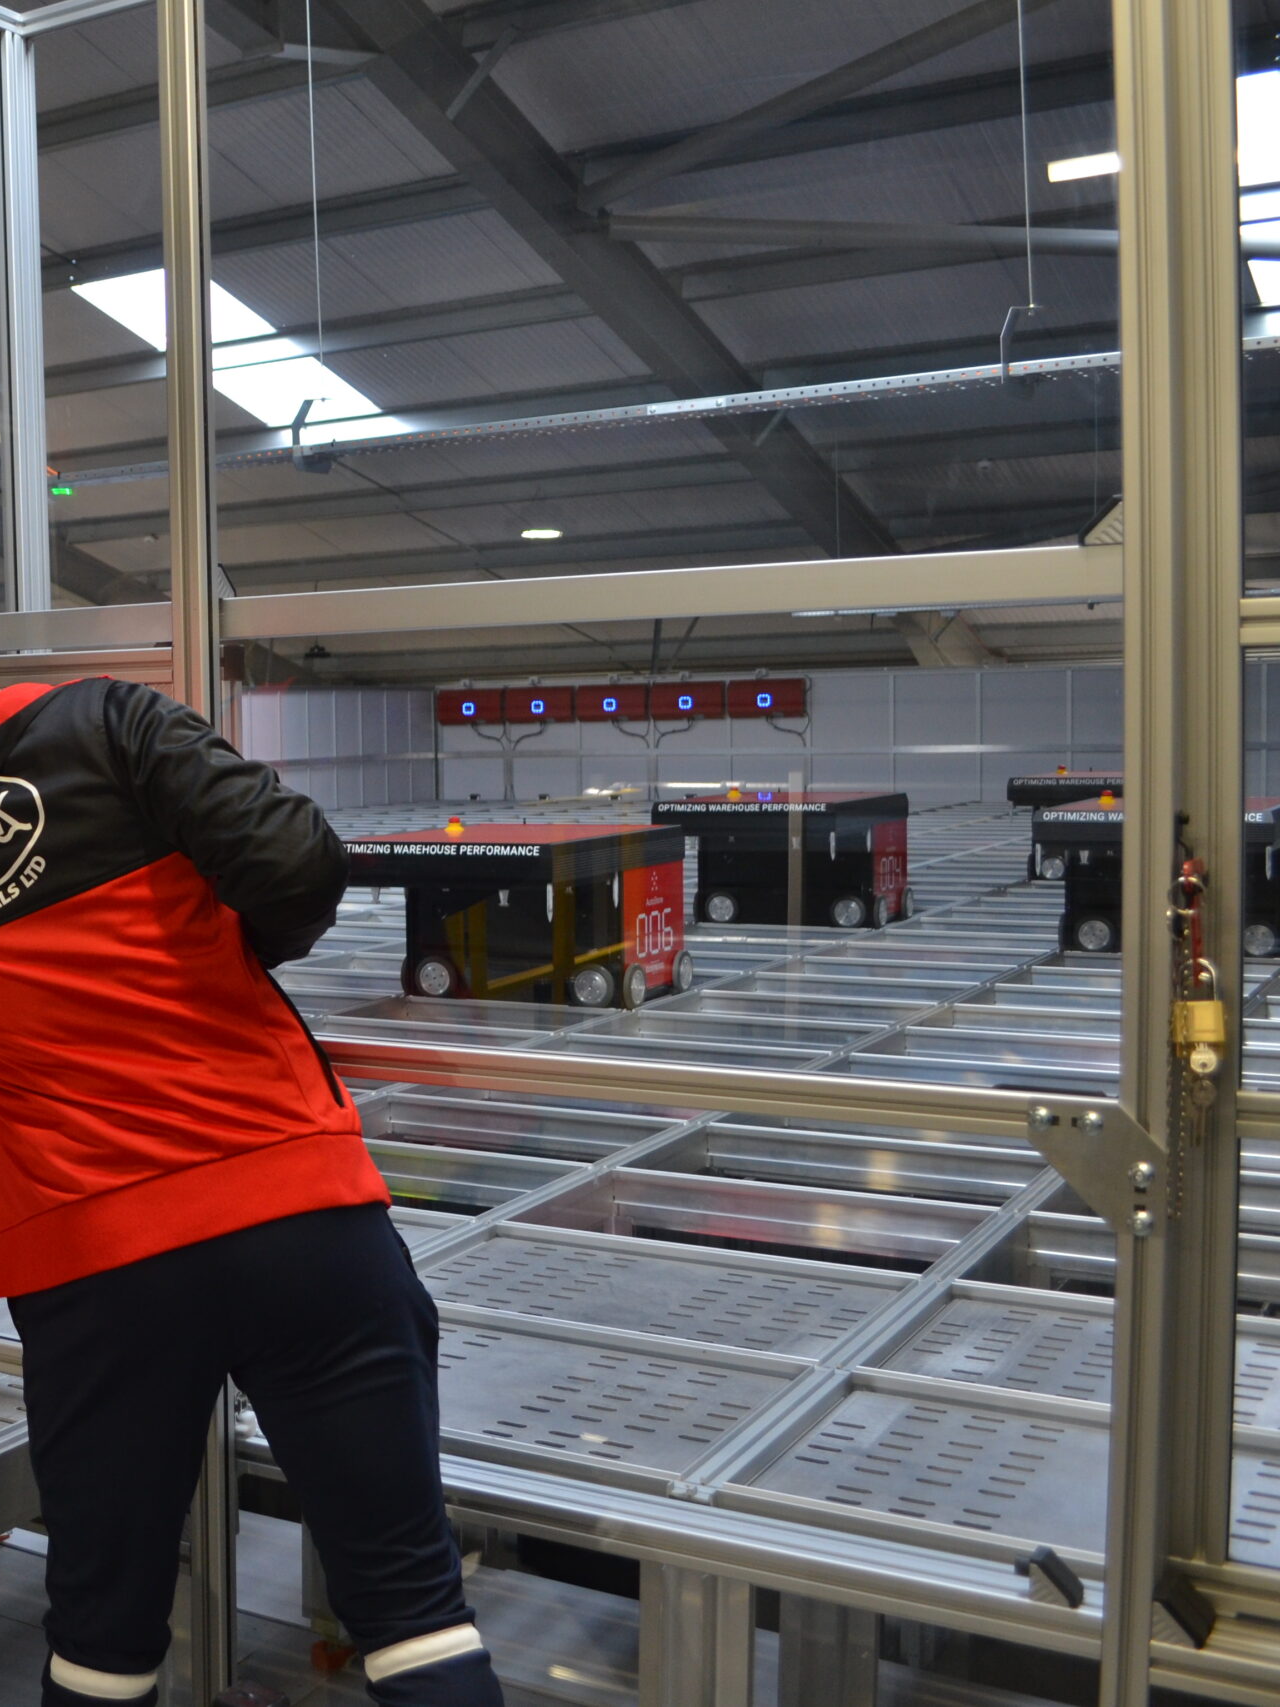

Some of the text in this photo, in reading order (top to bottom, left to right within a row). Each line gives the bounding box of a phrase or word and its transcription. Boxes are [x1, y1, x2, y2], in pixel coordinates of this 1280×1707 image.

[658, 804, 826, 812] OPTIMIZING WAREHOUSE PERFORMANCE
[1042, 811, 1105, 821] OPTIMIZING
[393, 845, 457, 855] WAREHOUSE
[459, 845, 540, 857] PERFORMANCE
[20, 855, 47, 889] LTD
[636, 907, 673, 958] 006
